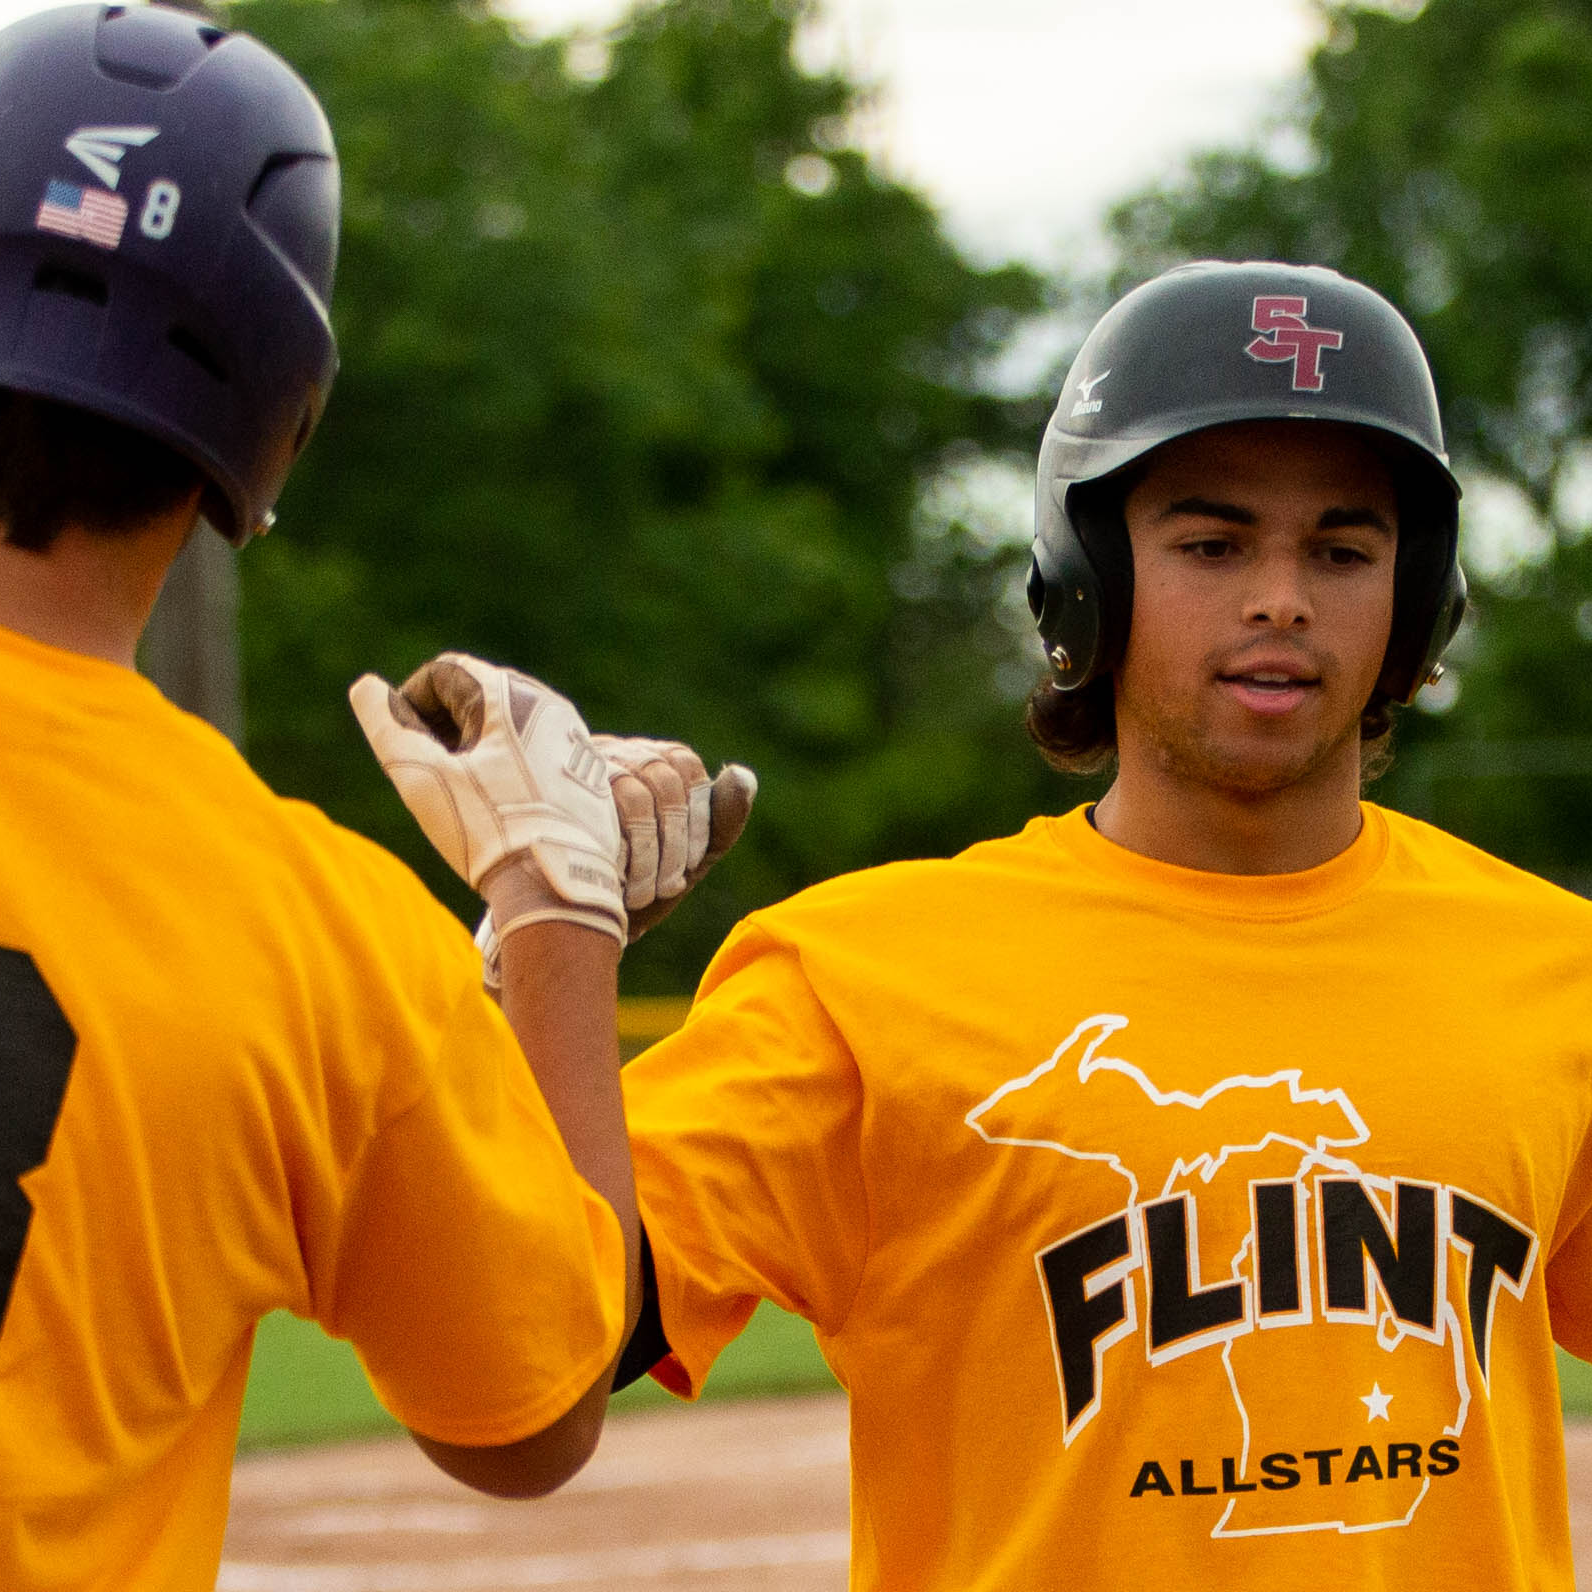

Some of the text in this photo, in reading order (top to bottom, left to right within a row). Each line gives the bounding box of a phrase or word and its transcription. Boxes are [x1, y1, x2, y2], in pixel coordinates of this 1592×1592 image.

[139, 178, 181, 240] 8
[1245, 296, 1343, 391] ST
[1034, 1173, 1539, 1449] FLINT
[1129, 1439, 1460, 1498] ALLSTARS
